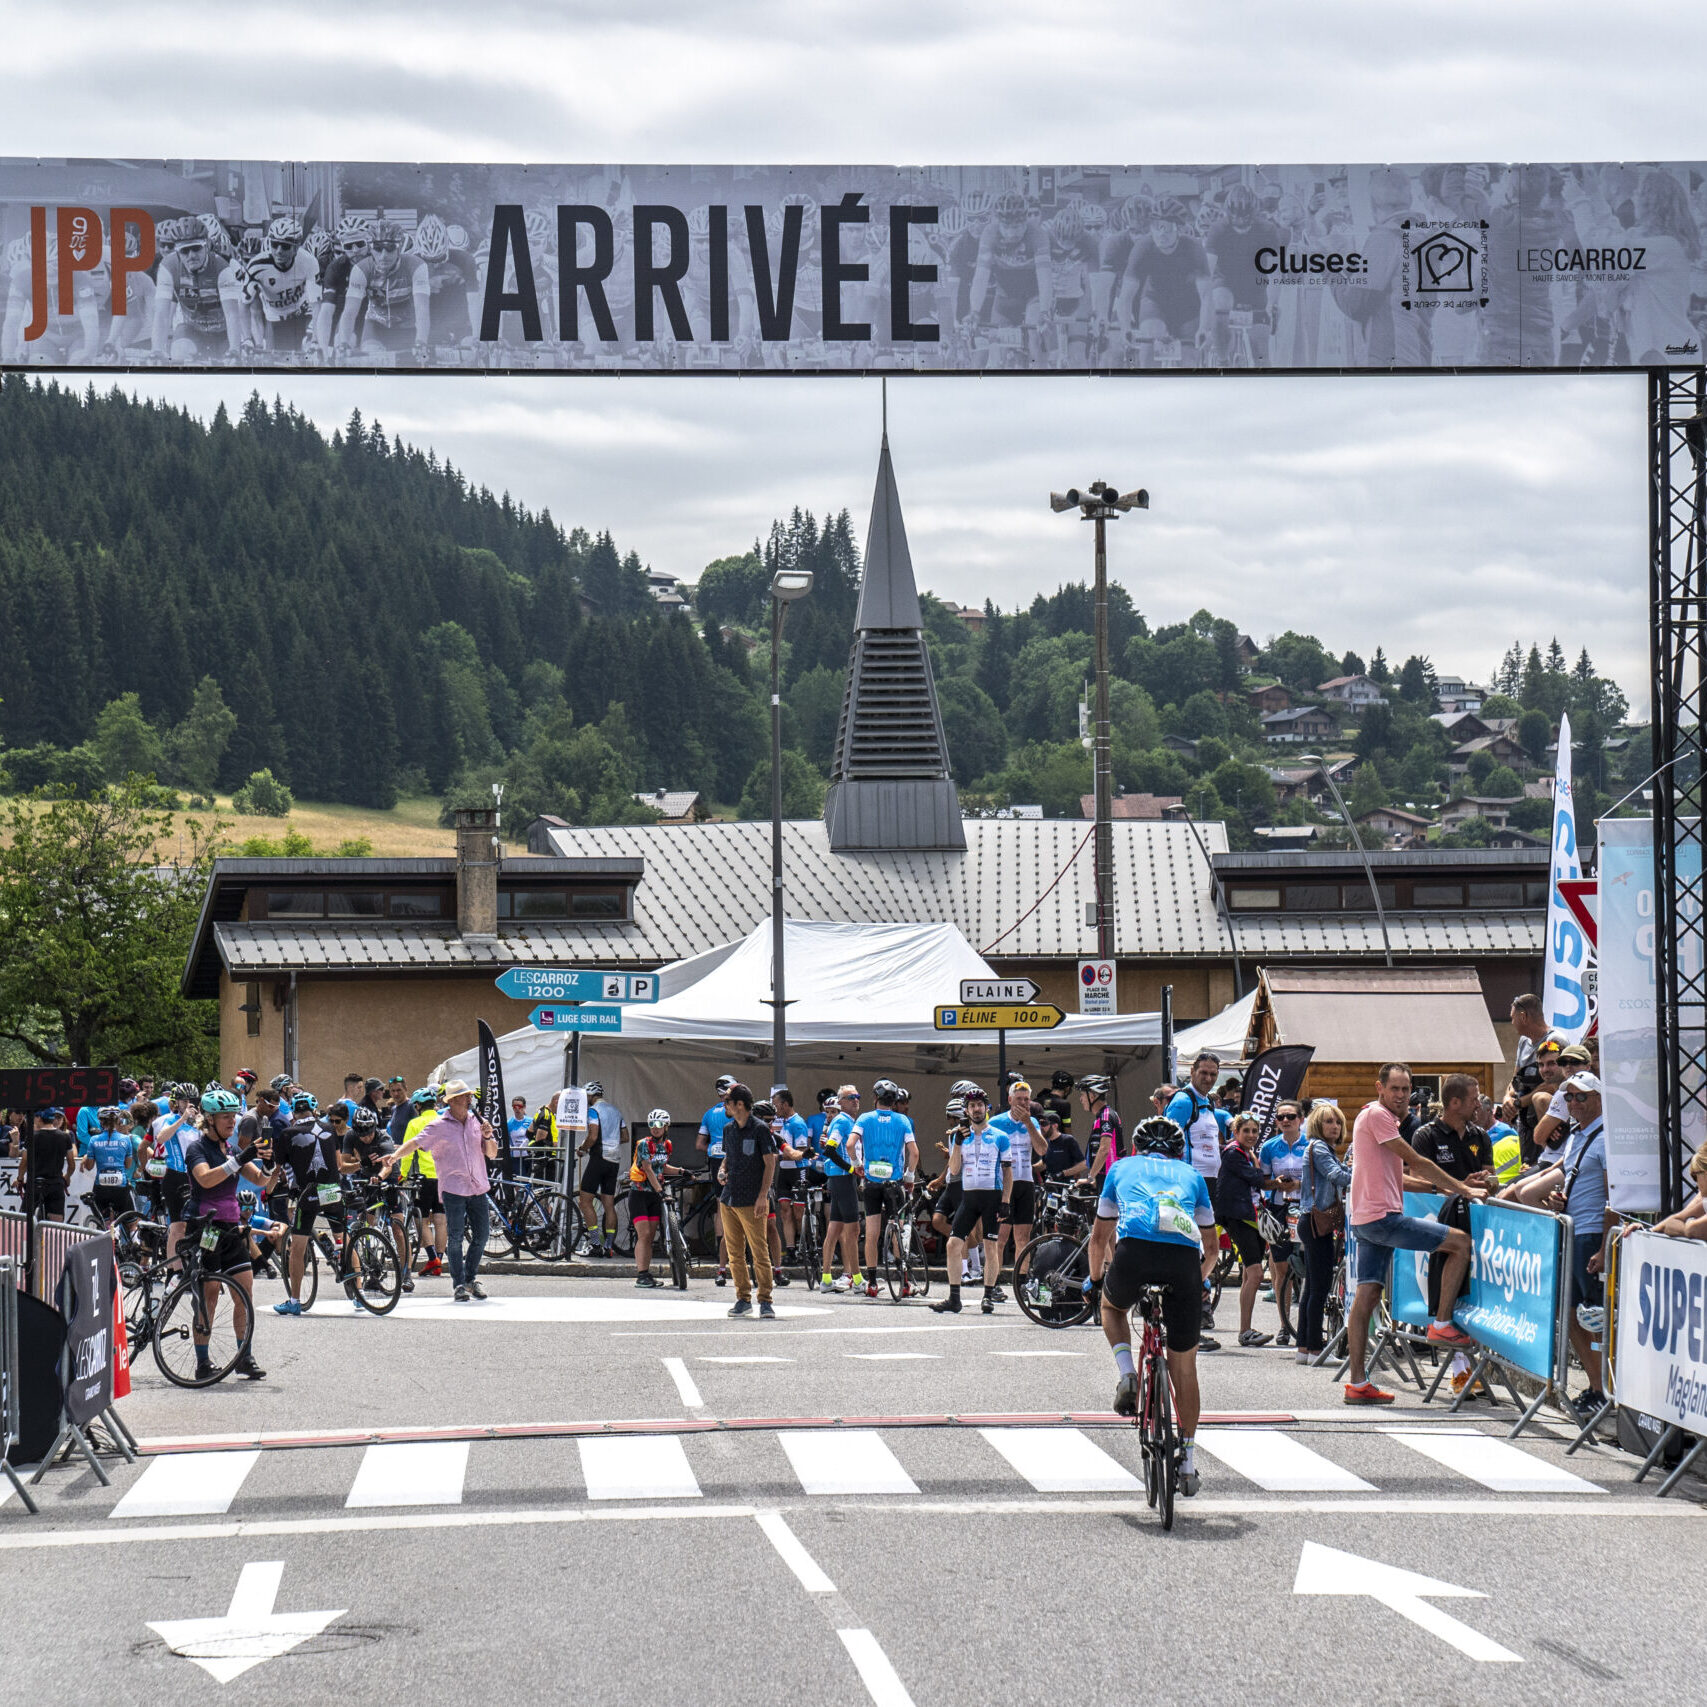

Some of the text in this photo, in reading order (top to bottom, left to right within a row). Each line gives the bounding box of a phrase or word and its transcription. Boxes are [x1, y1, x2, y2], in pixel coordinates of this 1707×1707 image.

[72, 216, 88, 235] 9
[1440, 221, 1450, 229] DE
[69, 234, 90, 249] DE
[479, 192, 940, 342] ARRIVÉE
[1517, 247, 1647, 271] LESCARROZ
[24, 206, 156, 341] JPP
[514, 971, 579, 985] LESCARROZ
[635, 980, 648, 996] P
[966, 985, 1025, 998] FLAINE
[557, 1013, 619, 1025] LUGE SUR RAIL
[944, 1012, 954, 1024] P
[961, 1008, 1051, 1024] ÉLINE 100 m
[103, 1176, 119, 1185] 1187
[1172, 1214, 1192, 1234] 498
[1480, 1228, 1542, 1303] Région
